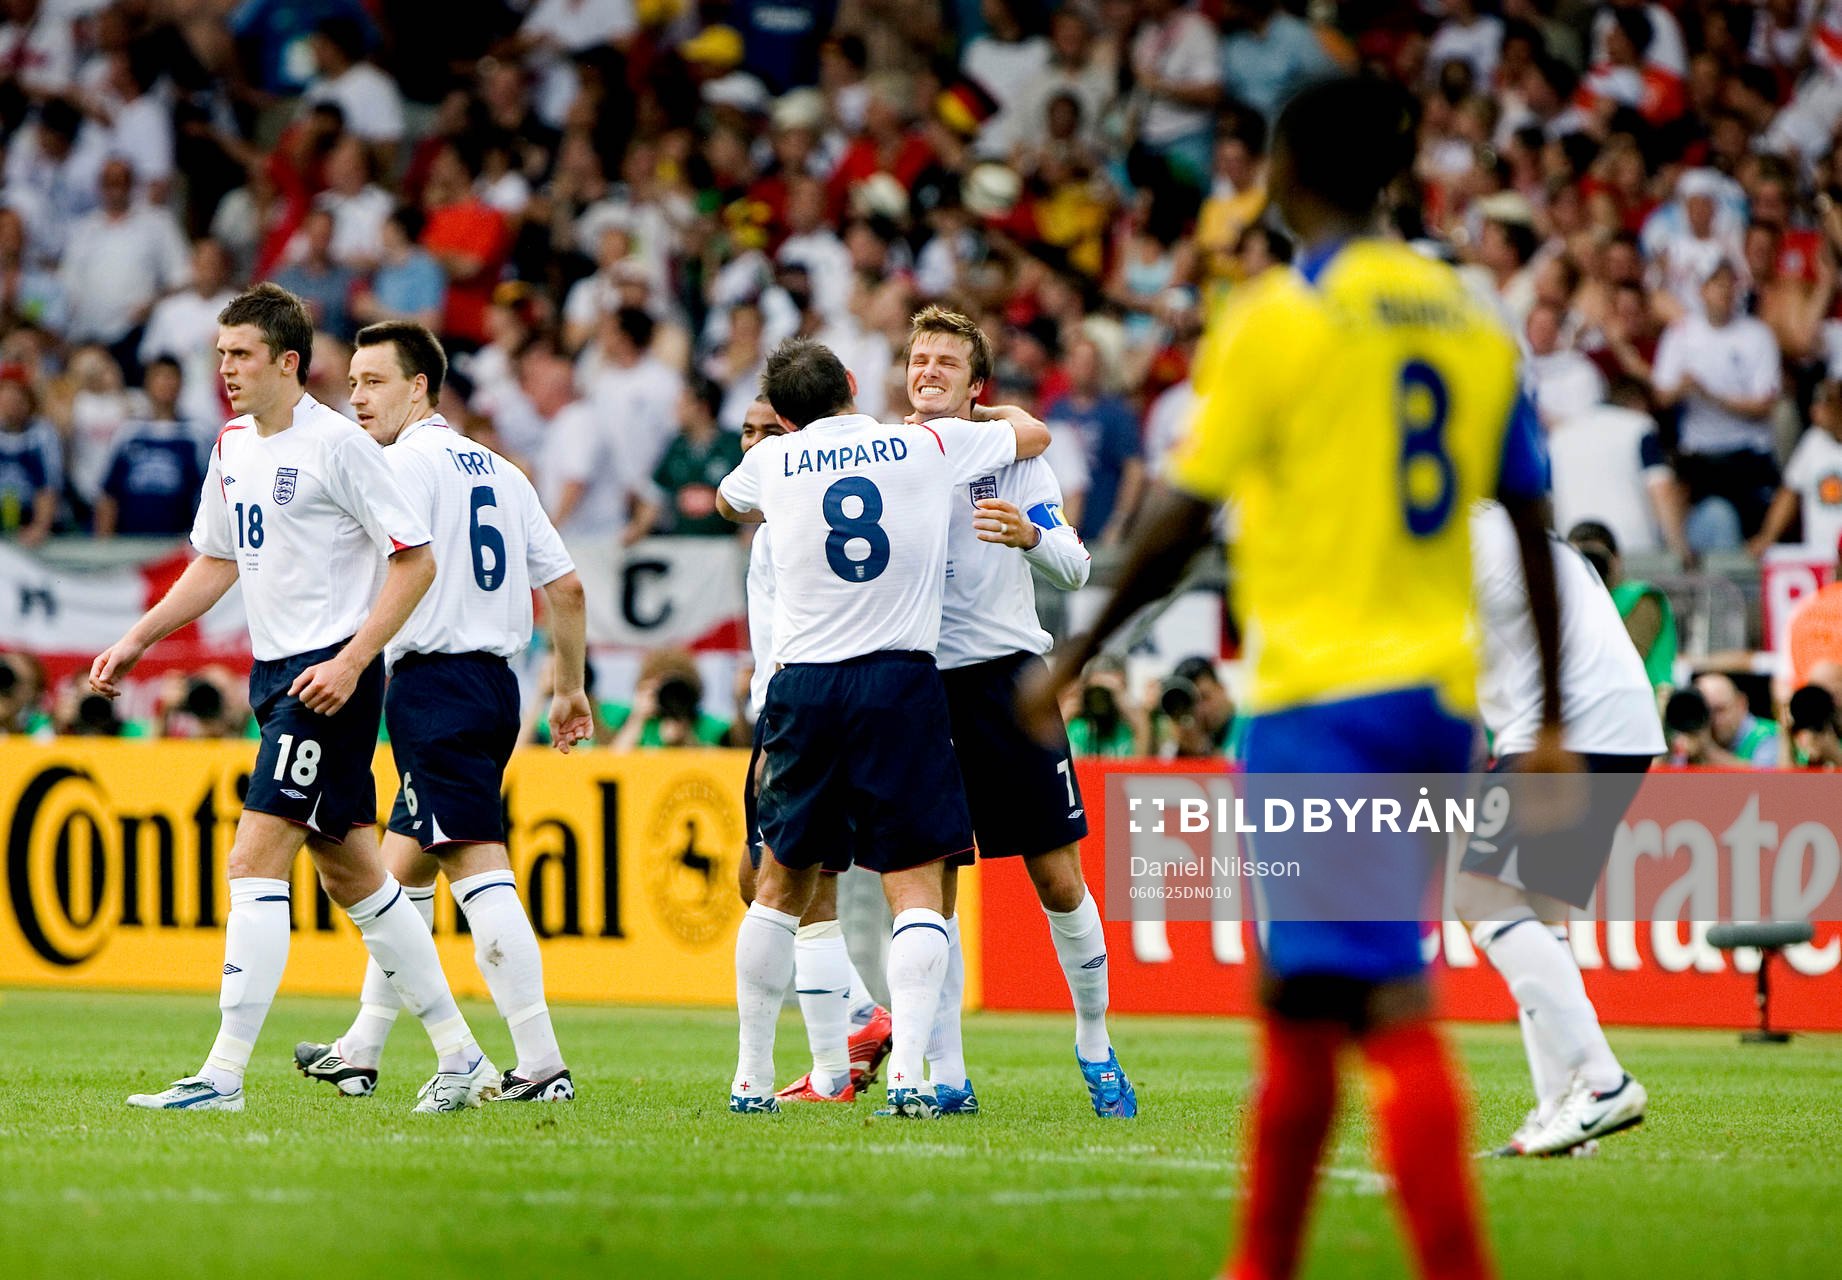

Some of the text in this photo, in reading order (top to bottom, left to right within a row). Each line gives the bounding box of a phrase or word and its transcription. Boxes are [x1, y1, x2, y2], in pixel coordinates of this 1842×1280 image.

[784, 437, 907, 477] LAMPARD
[1399, 357, 1457, 538] 8
[235, 502, 264, 549] 18
[469, 485, 506, 592] 6
[822, 476, 890, 583] 8
[273, 733, 322, 787] 18
[1056, 758, 1076, 808] 7
[404, 771, 418, 817] 6
[1475, 785, 1511, 839] 9
[8, 766, 625, 965] Contal
